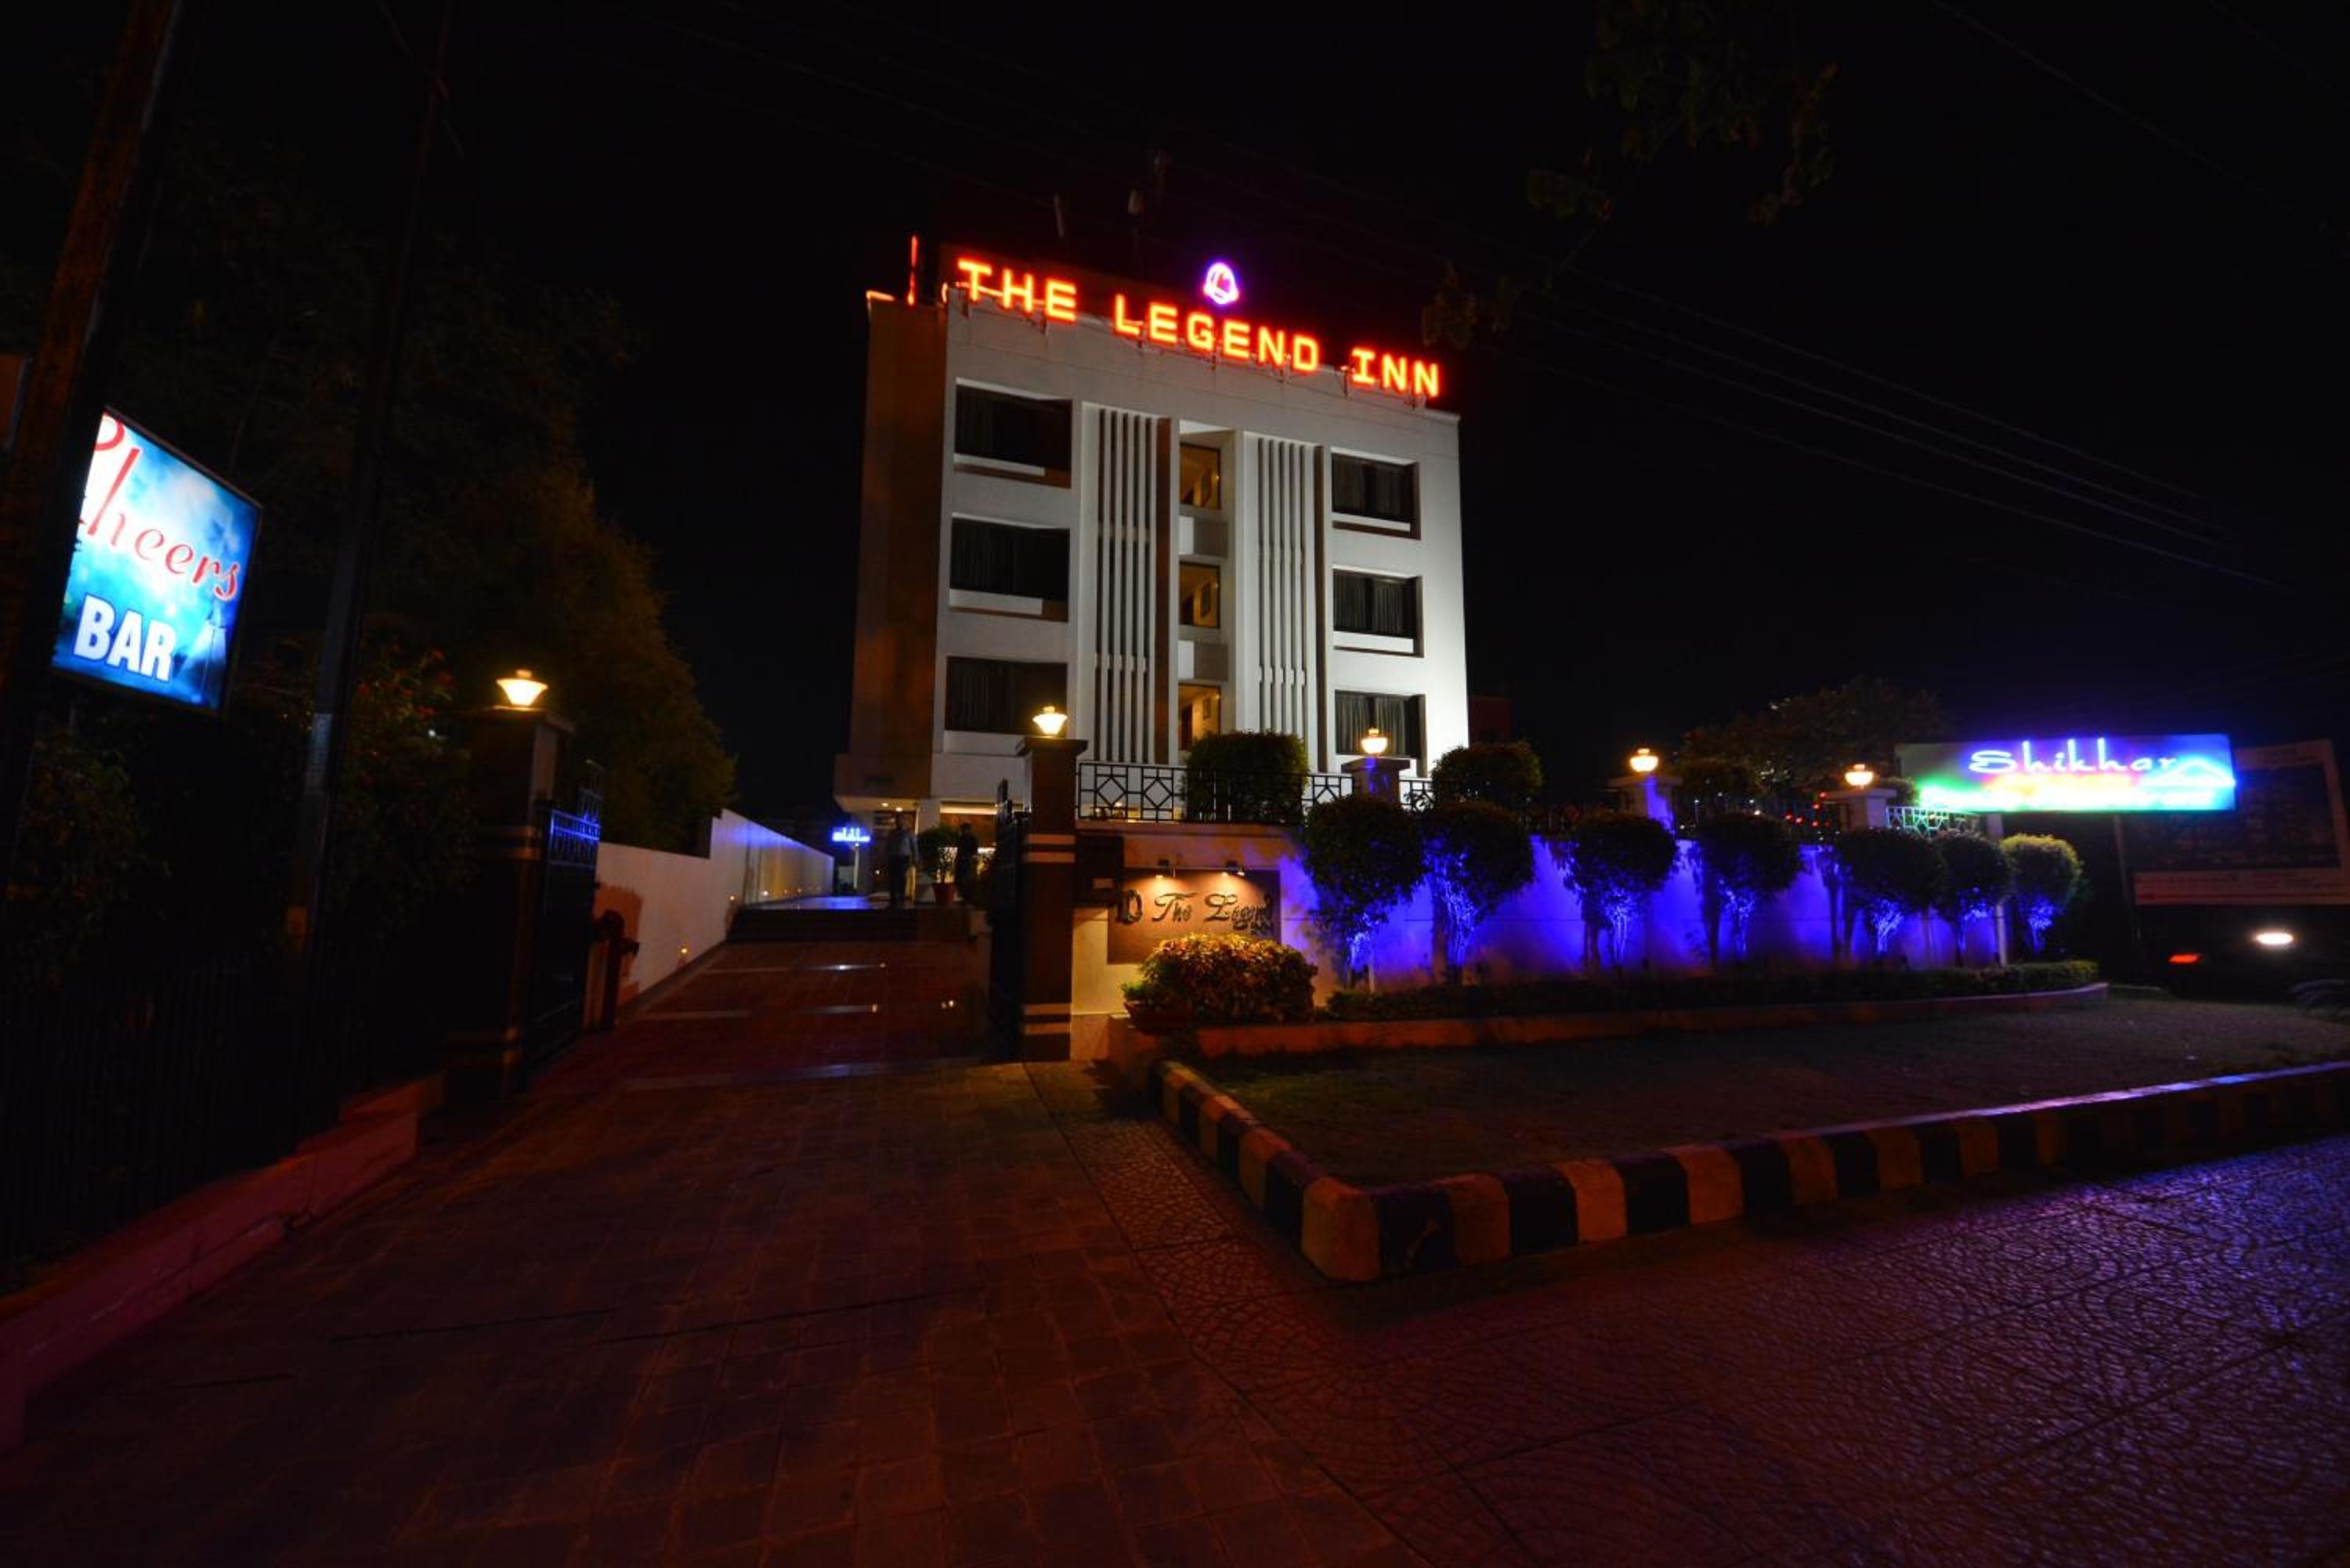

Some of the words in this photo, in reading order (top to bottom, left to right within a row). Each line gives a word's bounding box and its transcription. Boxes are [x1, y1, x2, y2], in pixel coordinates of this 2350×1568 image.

[956, 257, 1078, 323] THE
[1113, 292, 1321, 373] LEGEND
[1350, 346, 1440, 399] INN
[73, 593, 177, 682] BAR
[1968, 737, 2177, 774] Shikhar
